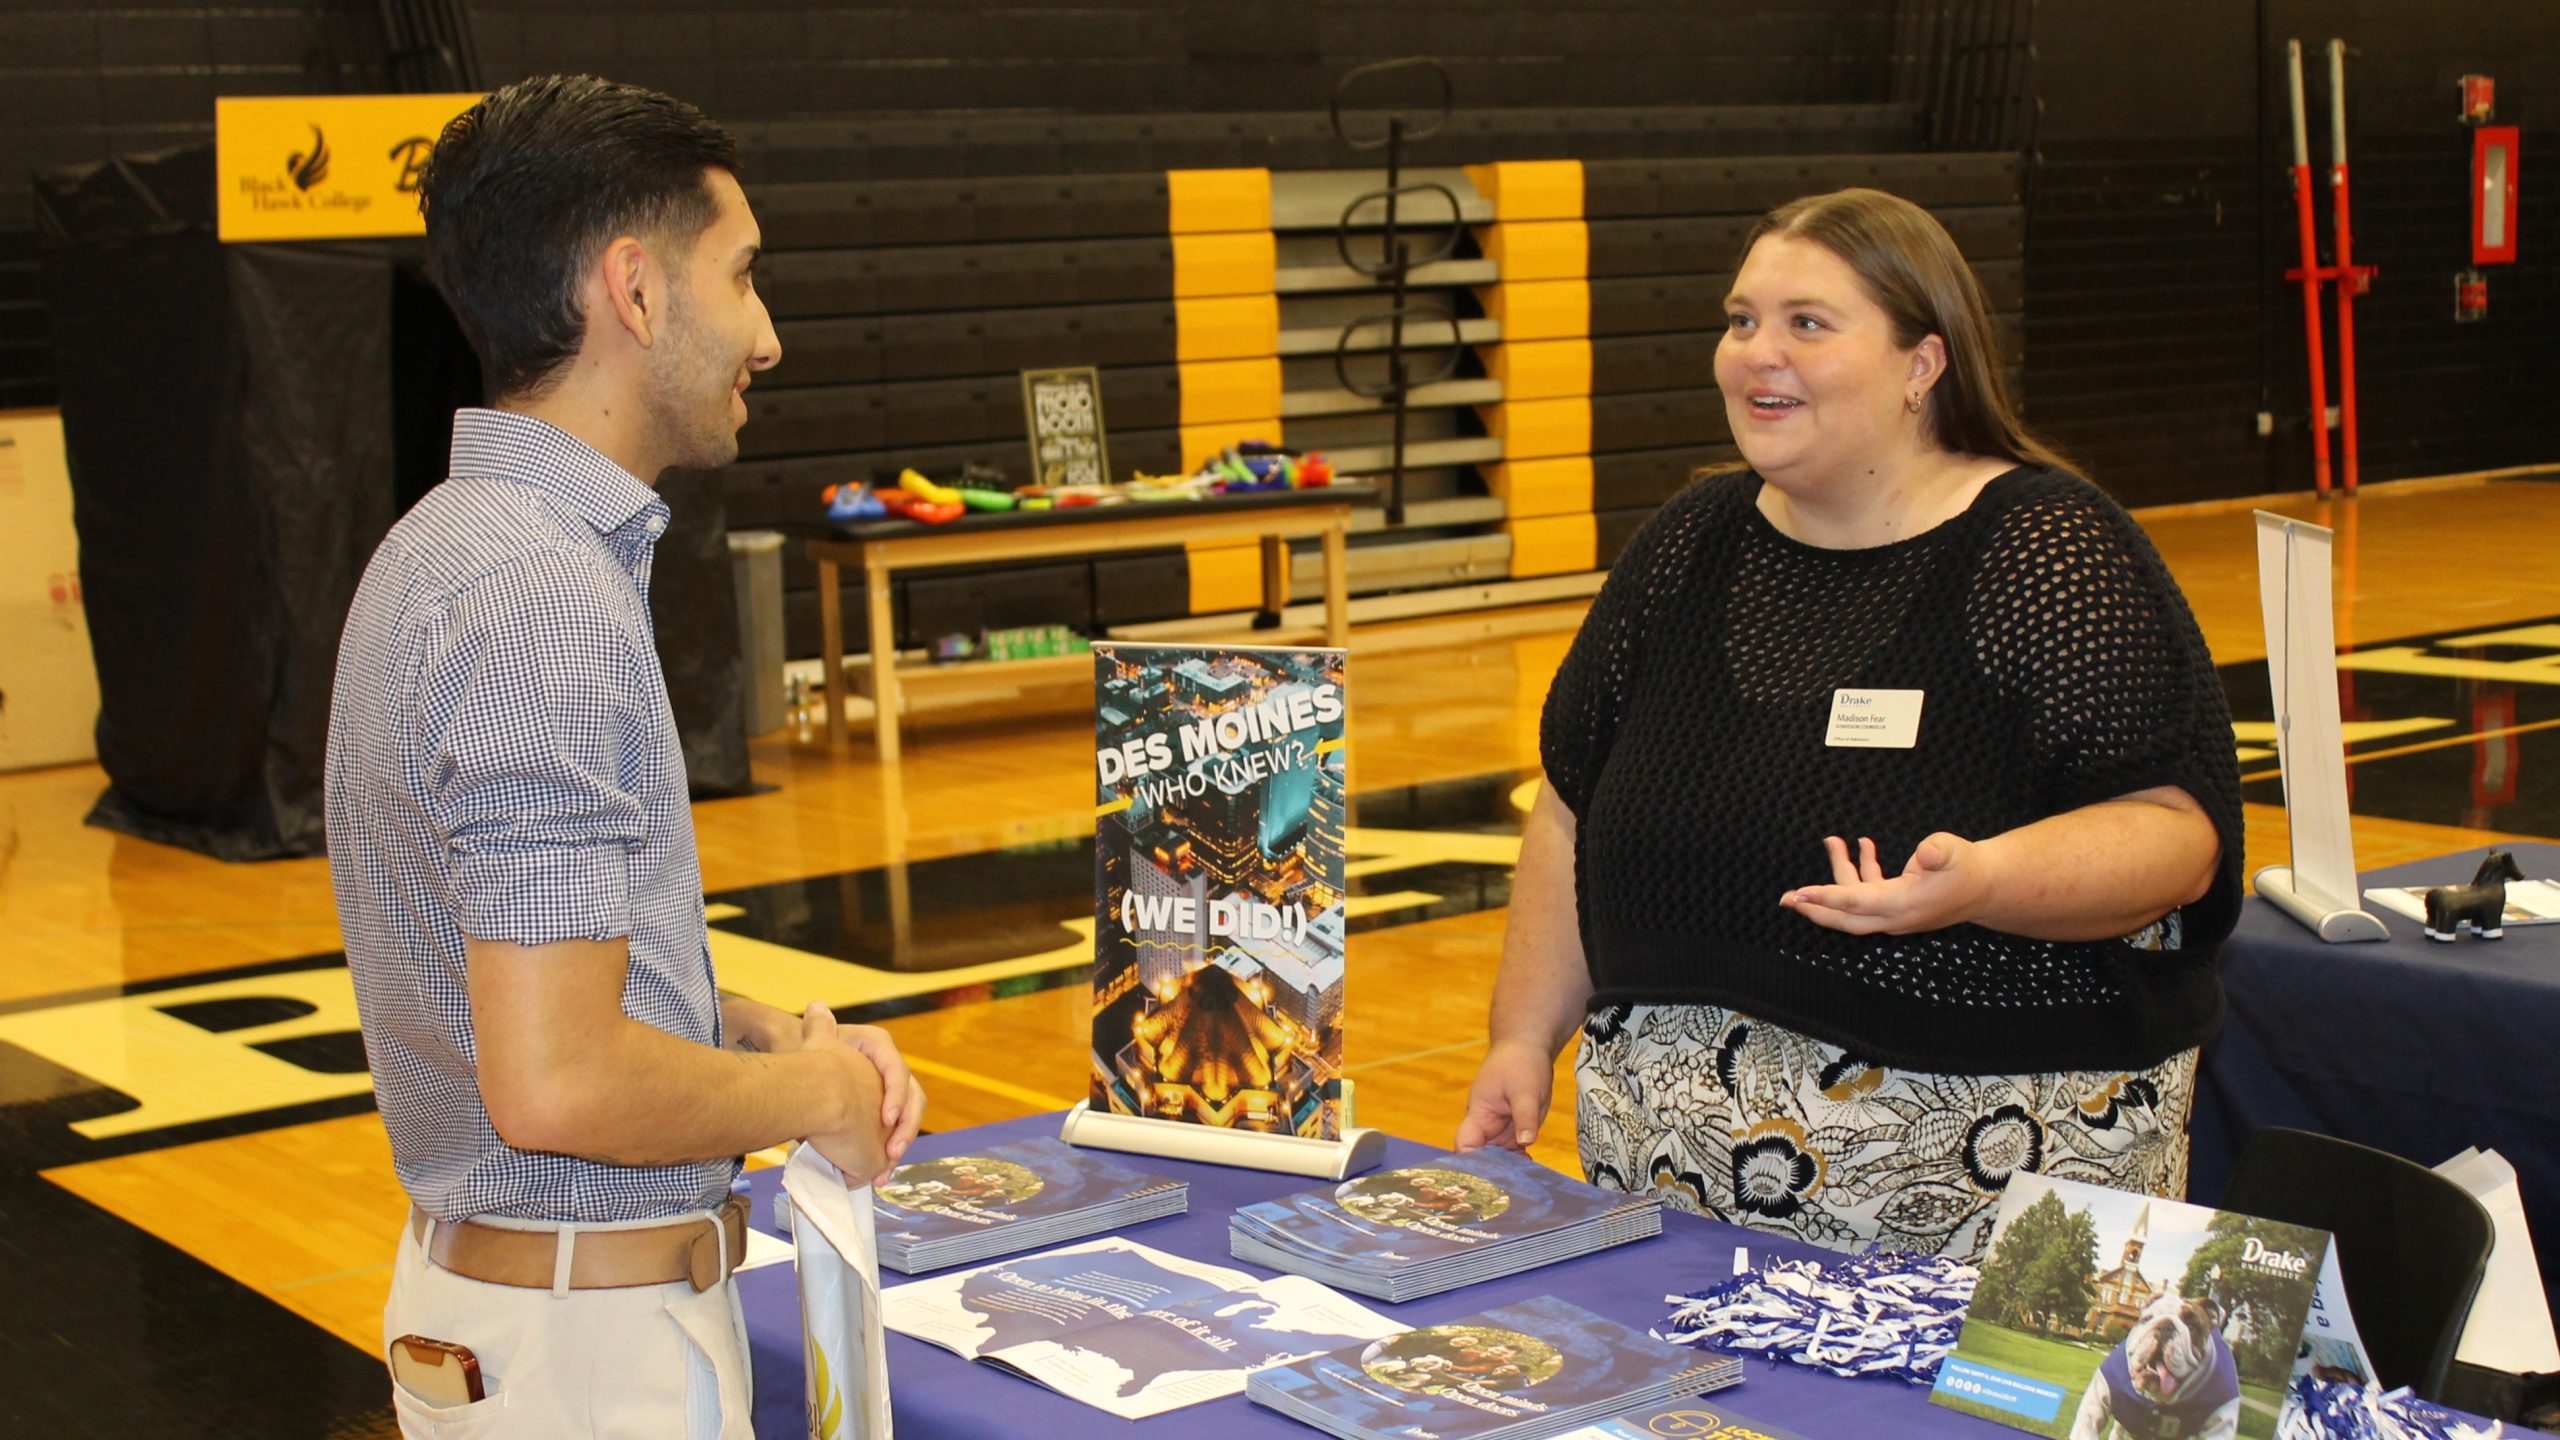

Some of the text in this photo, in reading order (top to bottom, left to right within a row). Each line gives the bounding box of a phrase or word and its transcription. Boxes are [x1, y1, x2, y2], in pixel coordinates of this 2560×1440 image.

[240, 176, 286, 194] Black
[252, 191, 371, 213] Hawk College
[1840, 693, 1872, 705] Drake
[1836, 713, 1886, 723] Madison Fear
[1097, 684, 1343, 786] DES MOINES
[1140, 740, 1309, 809] WHO KNEW?
[1121, 888, 1308, 947] (WE DID!)
[2241, 1237, 2307, 1273] Drake
[2240, 1261, 2301, 1281] UNIVERSITY
[994, 1271, 1036, 1290] Open
[1105, 1302, 1135, 1320] the
[1205, 1335, 1238, 1352] all.
